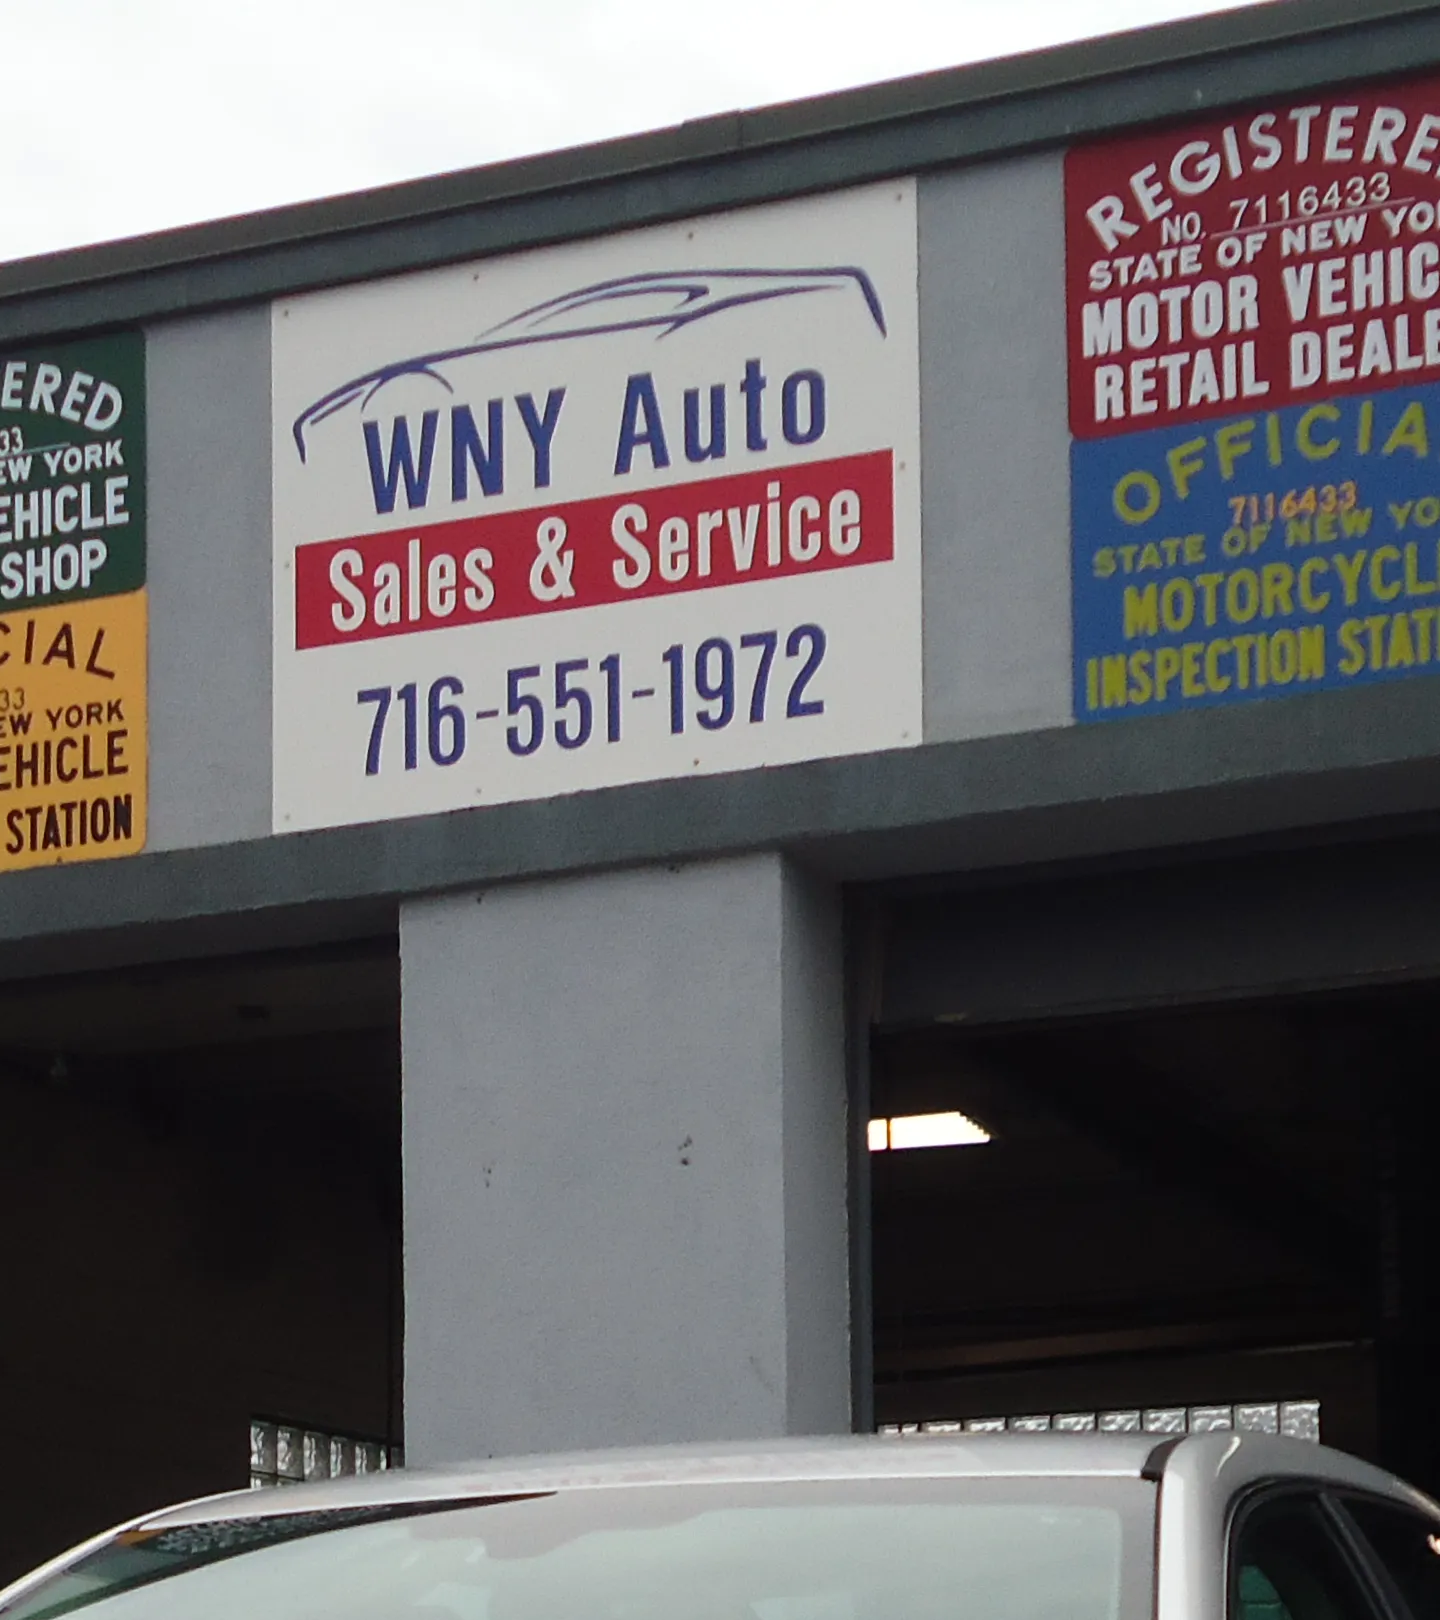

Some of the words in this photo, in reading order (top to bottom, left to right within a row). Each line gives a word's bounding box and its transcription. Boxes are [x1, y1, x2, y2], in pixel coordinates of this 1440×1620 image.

[1162, 211, 1208, 247] NO.
[1228, 171, 1391, 229] 7116433
[1088, 243, 1203, 292] STATE
[1216, 231, 1268, 269] OF
[1280, 214, 1369, 257] NEW
[1081, 274, 1261, 359] MOTOR
[1094, 339, 1270, 423] RETAIL
[45, 438, 125, 477] YORK
[362, 385, 568, 516] WNY
[614, 357, 827, 477] Auto
[1091, 532, 1207, 579] STATE
[1221, 521, 1270, 557] OF
[1284, 503, 1373, 549] NEW
[1228, 480, 1358, 526] 7116433
[0, 538, 108, 600] SHOP
[328, 538, 495, 632] Sales
[528, 515, 576, 602] &
[611, 480, 861, 589] Service
[356, 622, 828, 777] 716-551-1972
[1085, 623, 1326, 711] INSPECTION
[46, 698, 126, 731] YORK
[5, 793, 133, 856] STATION
